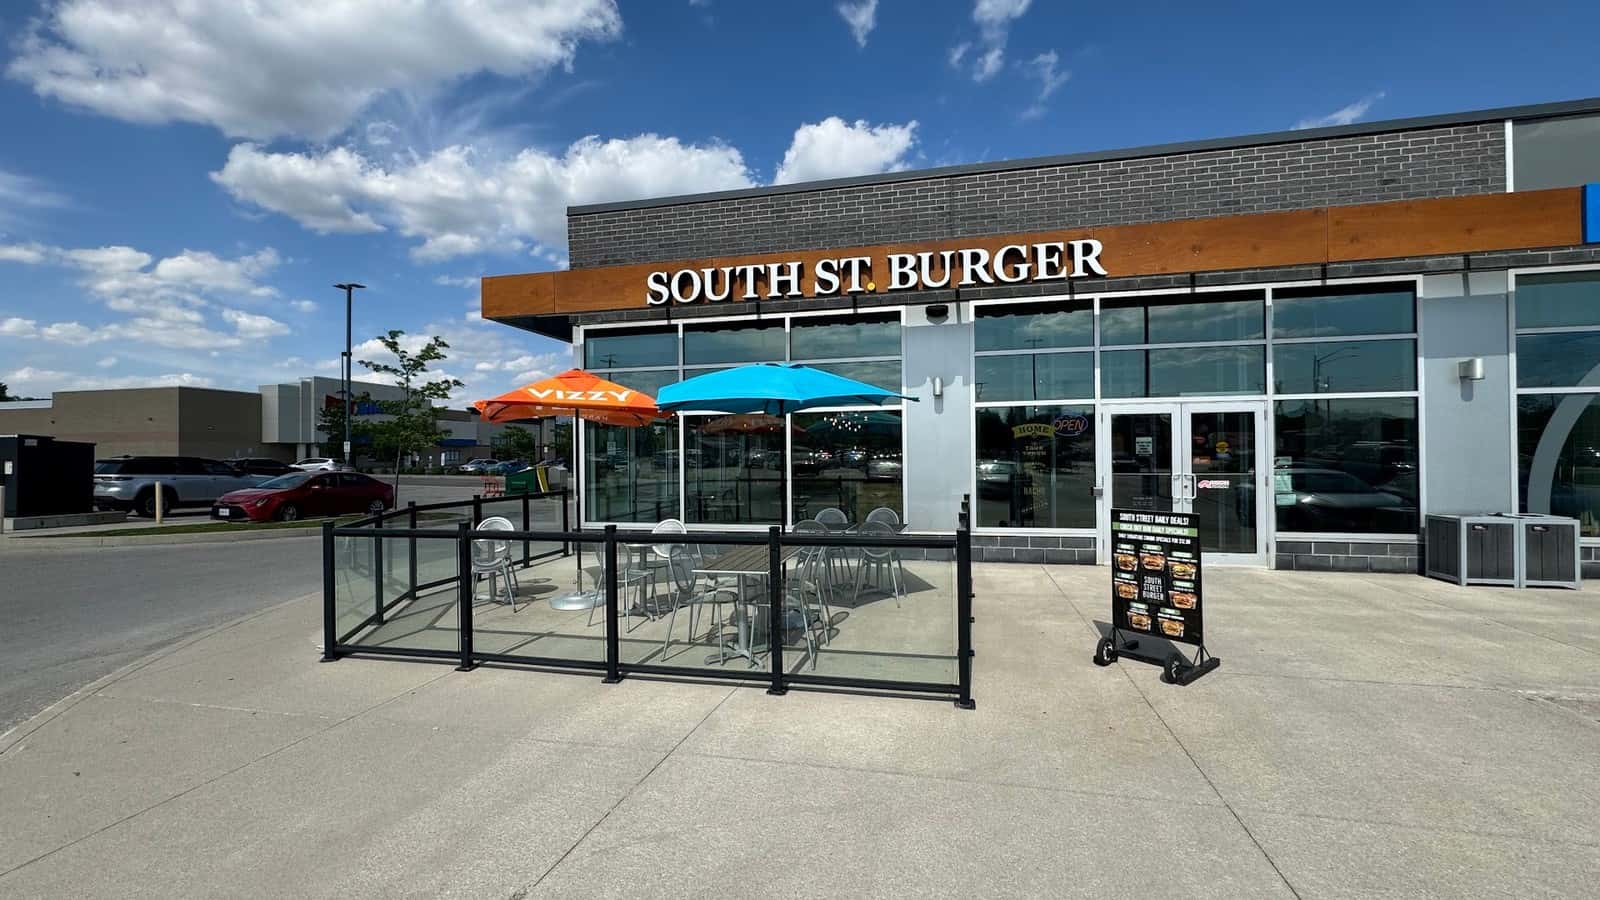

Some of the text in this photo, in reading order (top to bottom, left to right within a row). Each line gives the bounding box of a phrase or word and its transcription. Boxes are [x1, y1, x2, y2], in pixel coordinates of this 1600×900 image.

[646, 239, 1108, 305] SOUTH ST. BURGER
[528, 388, 631, 402] VIZZY
[1020, 424, 1048, 434] HOME
[1055, 419, 1085, 431] OPEN
[1119, 512, 1135, 522] SOUTH
[1136, 514, 1154, 523] STREET
[1154, 515, 1169, 524] DAILY
[1143, 575, 1162, 585] SOUTH
[1143, 583, 1162, 592] STREET
[1142, 590, 1164, 601] BURGER
